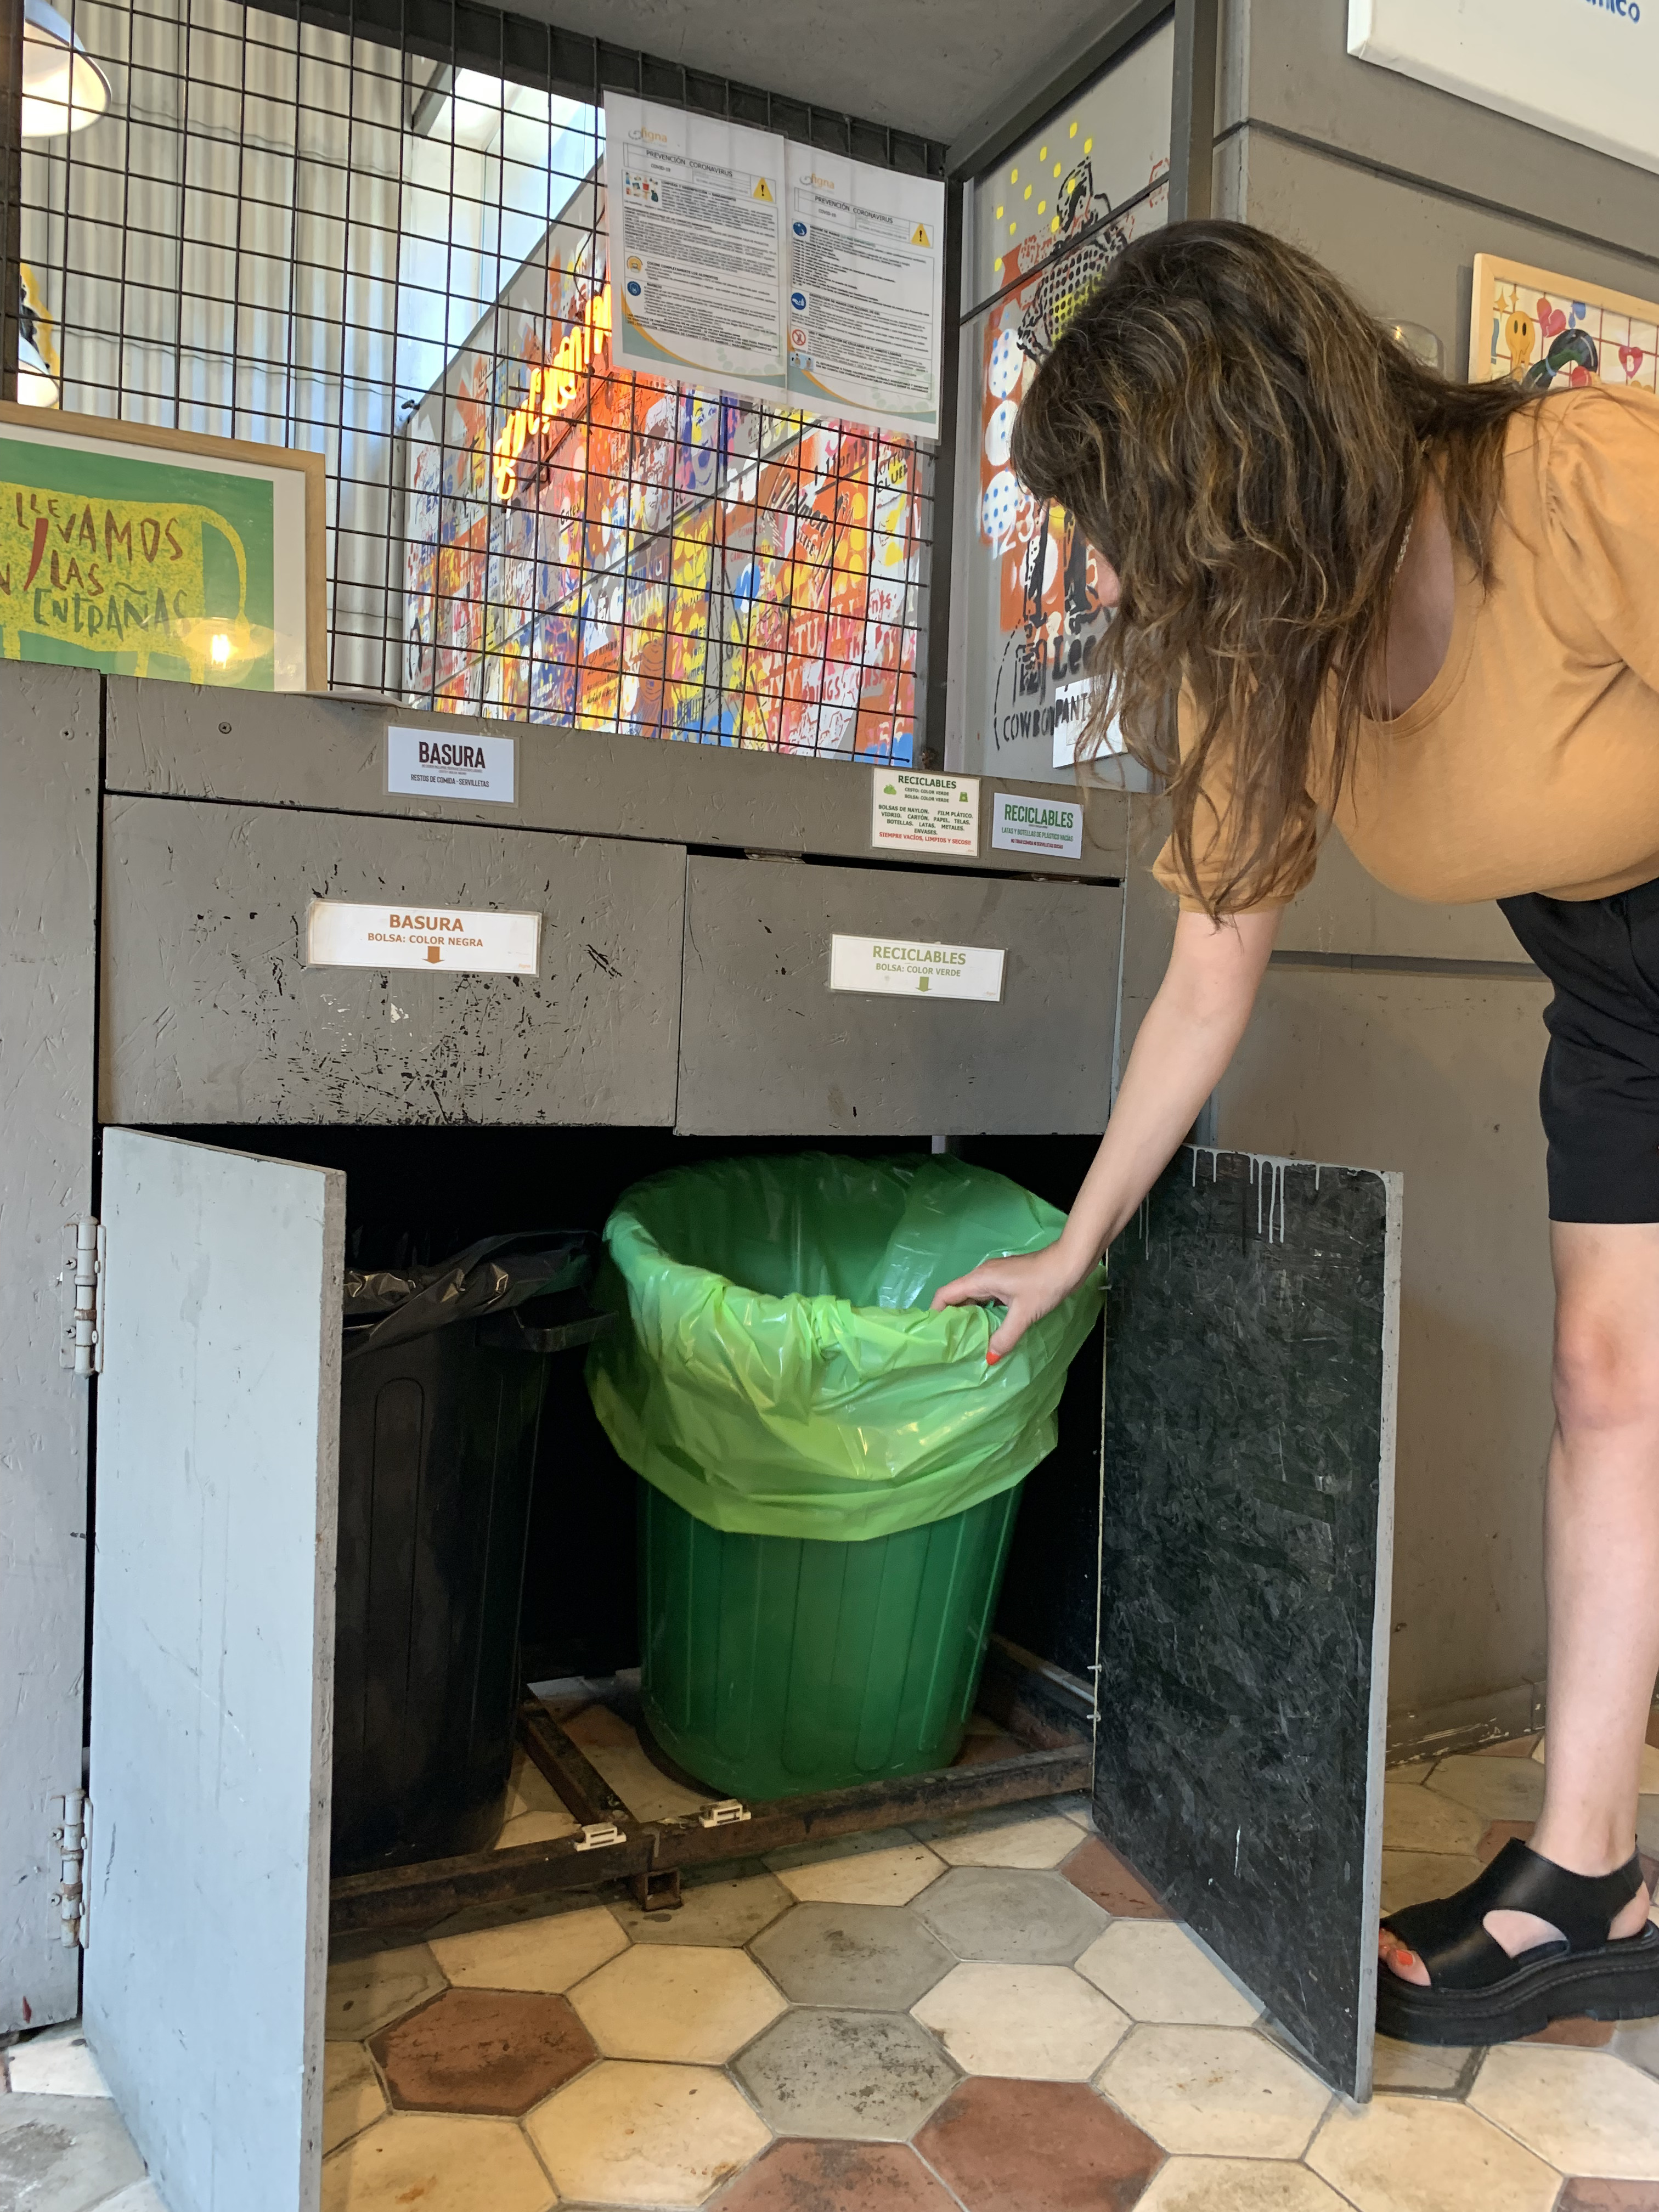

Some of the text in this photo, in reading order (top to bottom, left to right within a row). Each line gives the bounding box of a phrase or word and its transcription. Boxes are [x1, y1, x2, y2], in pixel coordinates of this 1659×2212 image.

[646, 150, 733, 177] PREVENCIÓN CORONAVIRUS
[815, 195, 893, 223] PREVENCIÓN CORONAVIRUS
[16, 492, 183, 564] LLEVAMOS
[50, 550, 104, 596] LAS
[419, 741, 486, 769] BASURA
[459, 778, 489, 787] SERVILLETAS
[898, 775, 957, 789] RECICLABLES
[1005, 804, 1074, 829] RECICLABLES
[1017, 829, 1036, 837] BOTELLAS
[390, 913, 464, 932] BASURA
[368, 933, 483, 947] BOLSA: COLOR NEGRA
[872, 945, 966, 965] RECICLABLES
[876, 963, 961, 977] BOLSA: COLOR VERDE
